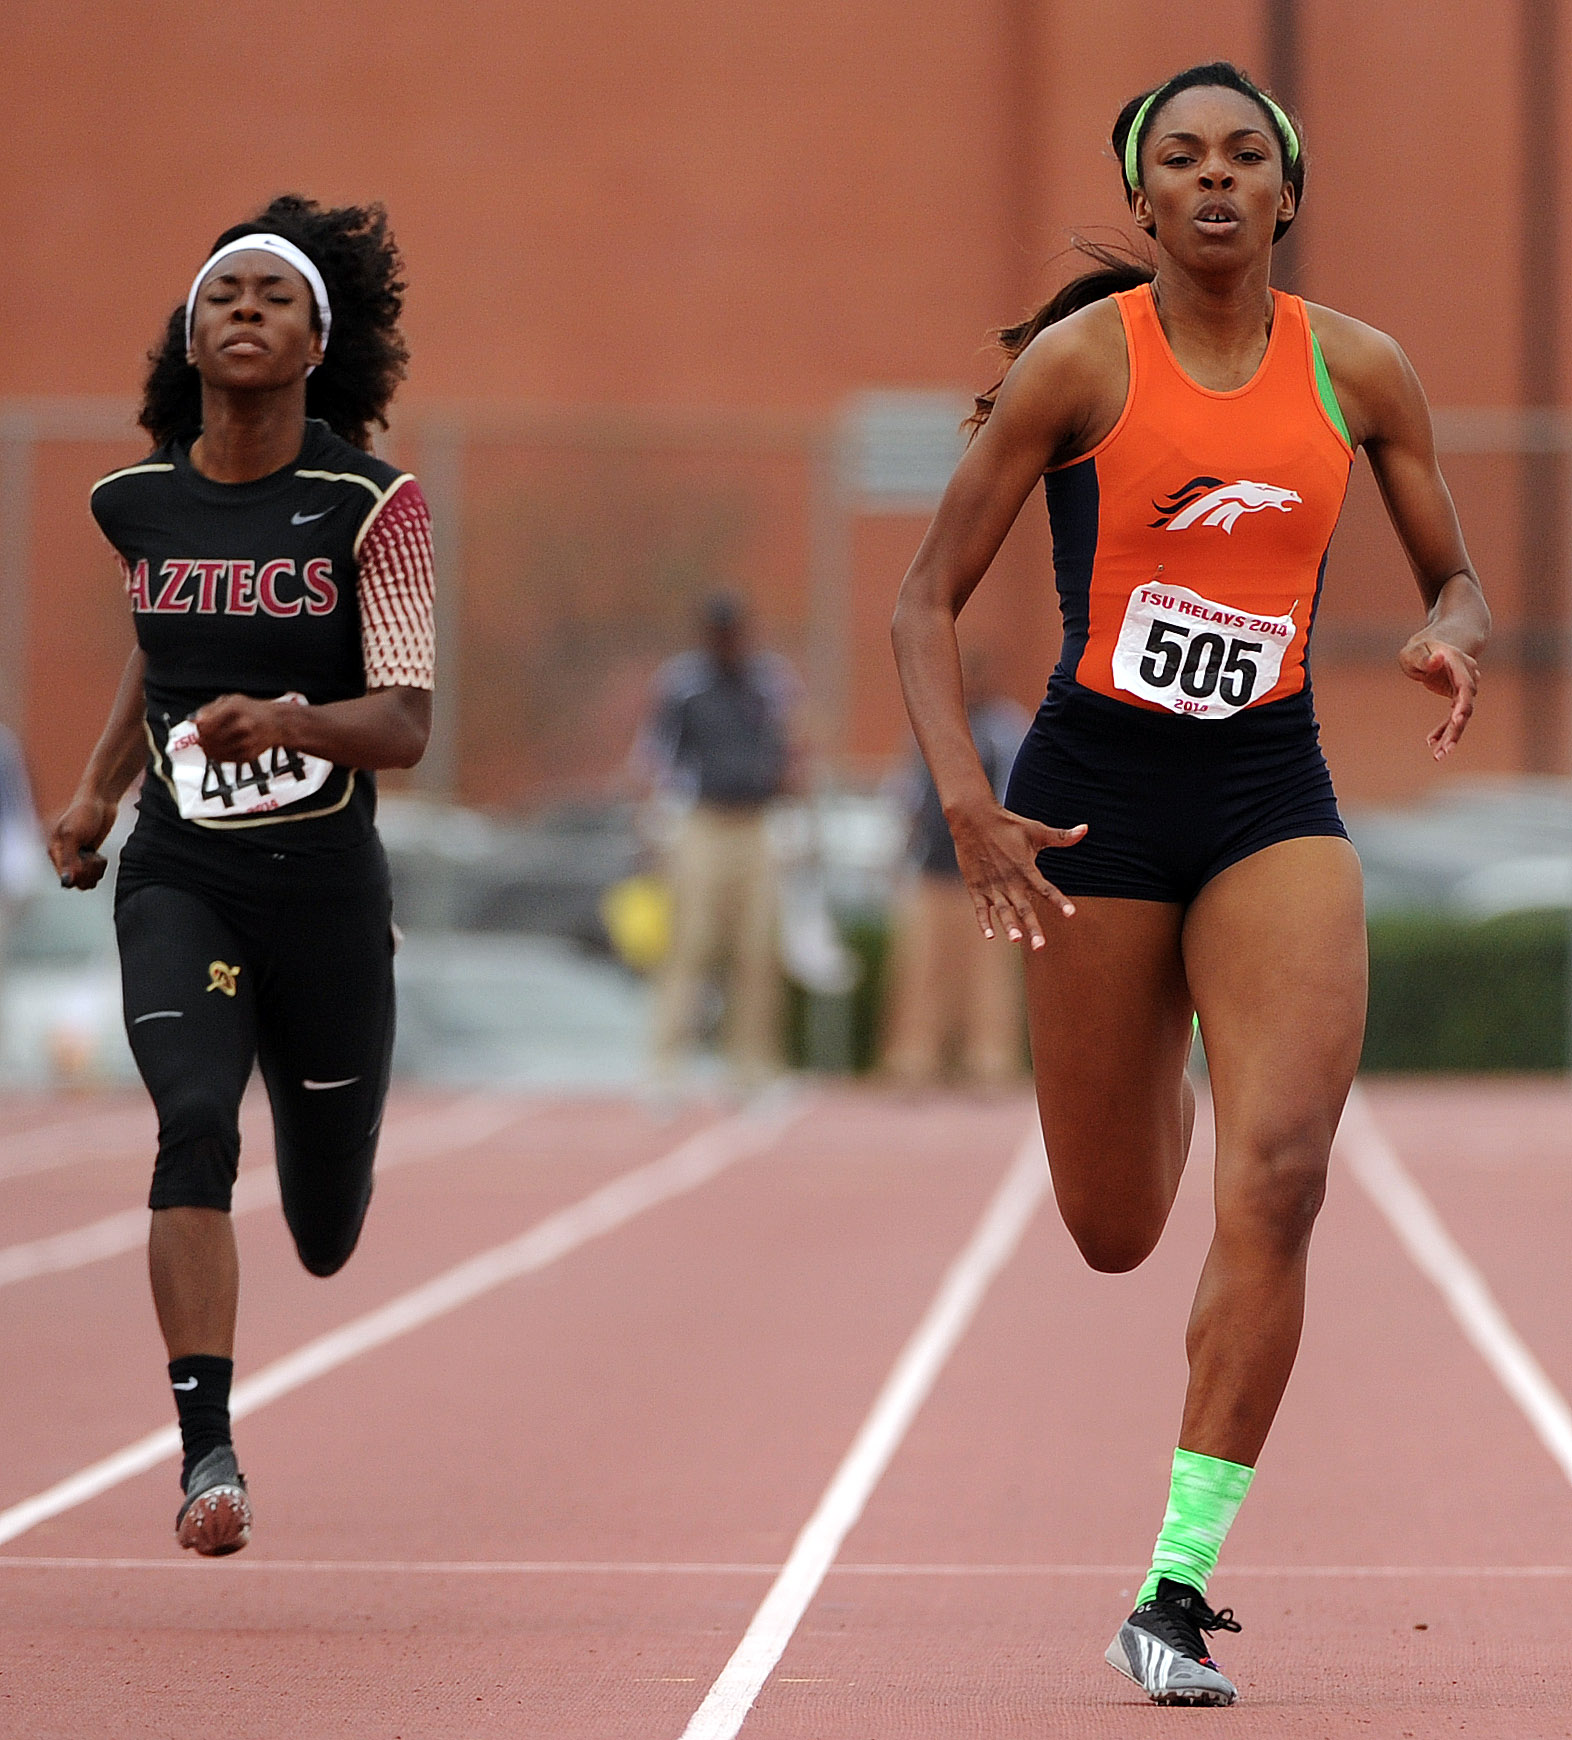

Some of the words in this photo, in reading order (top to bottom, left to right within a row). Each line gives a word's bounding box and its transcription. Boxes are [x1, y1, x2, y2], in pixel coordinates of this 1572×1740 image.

[131, 558, 338, 617] AZTECS
[1140, 590, 1175, 609] TSU
[1178, 600, 1246, 629] RELAYS
[1249, 618, 1289, 637] 2014
[1139, 619, 1263, 707] 505
[1173, 698, 1209, 713] 2014
[202, 745, 306, 809] 444
